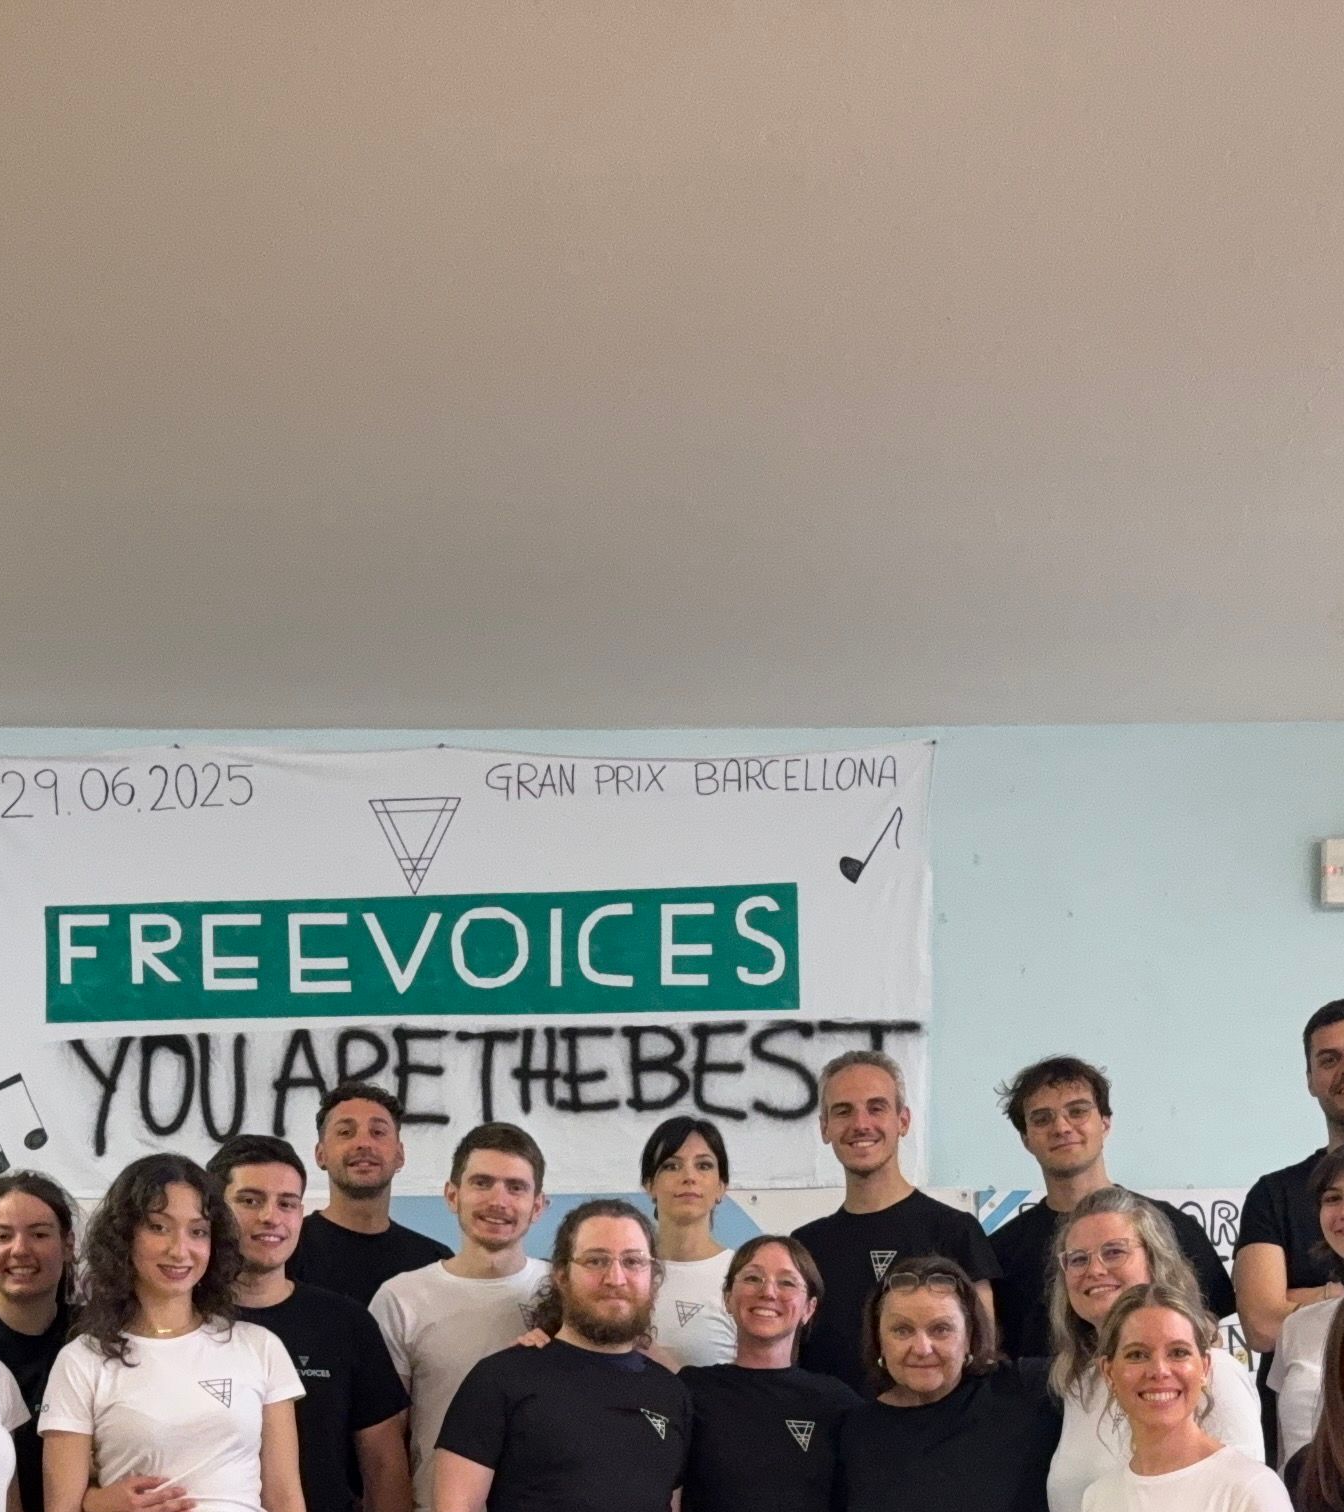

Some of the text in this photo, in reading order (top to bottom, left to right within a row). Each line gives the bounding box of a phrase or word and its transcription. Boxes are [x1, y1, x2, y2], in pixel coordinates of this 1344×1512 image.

[0, 761, 255, 819] 29.06.2025
[484, 755, 898, 801] GRAN PRIX BARCELLONA
[57, 894, 789, 995] FREEVOICES
[67, 1031, 247, 1157] YOU
